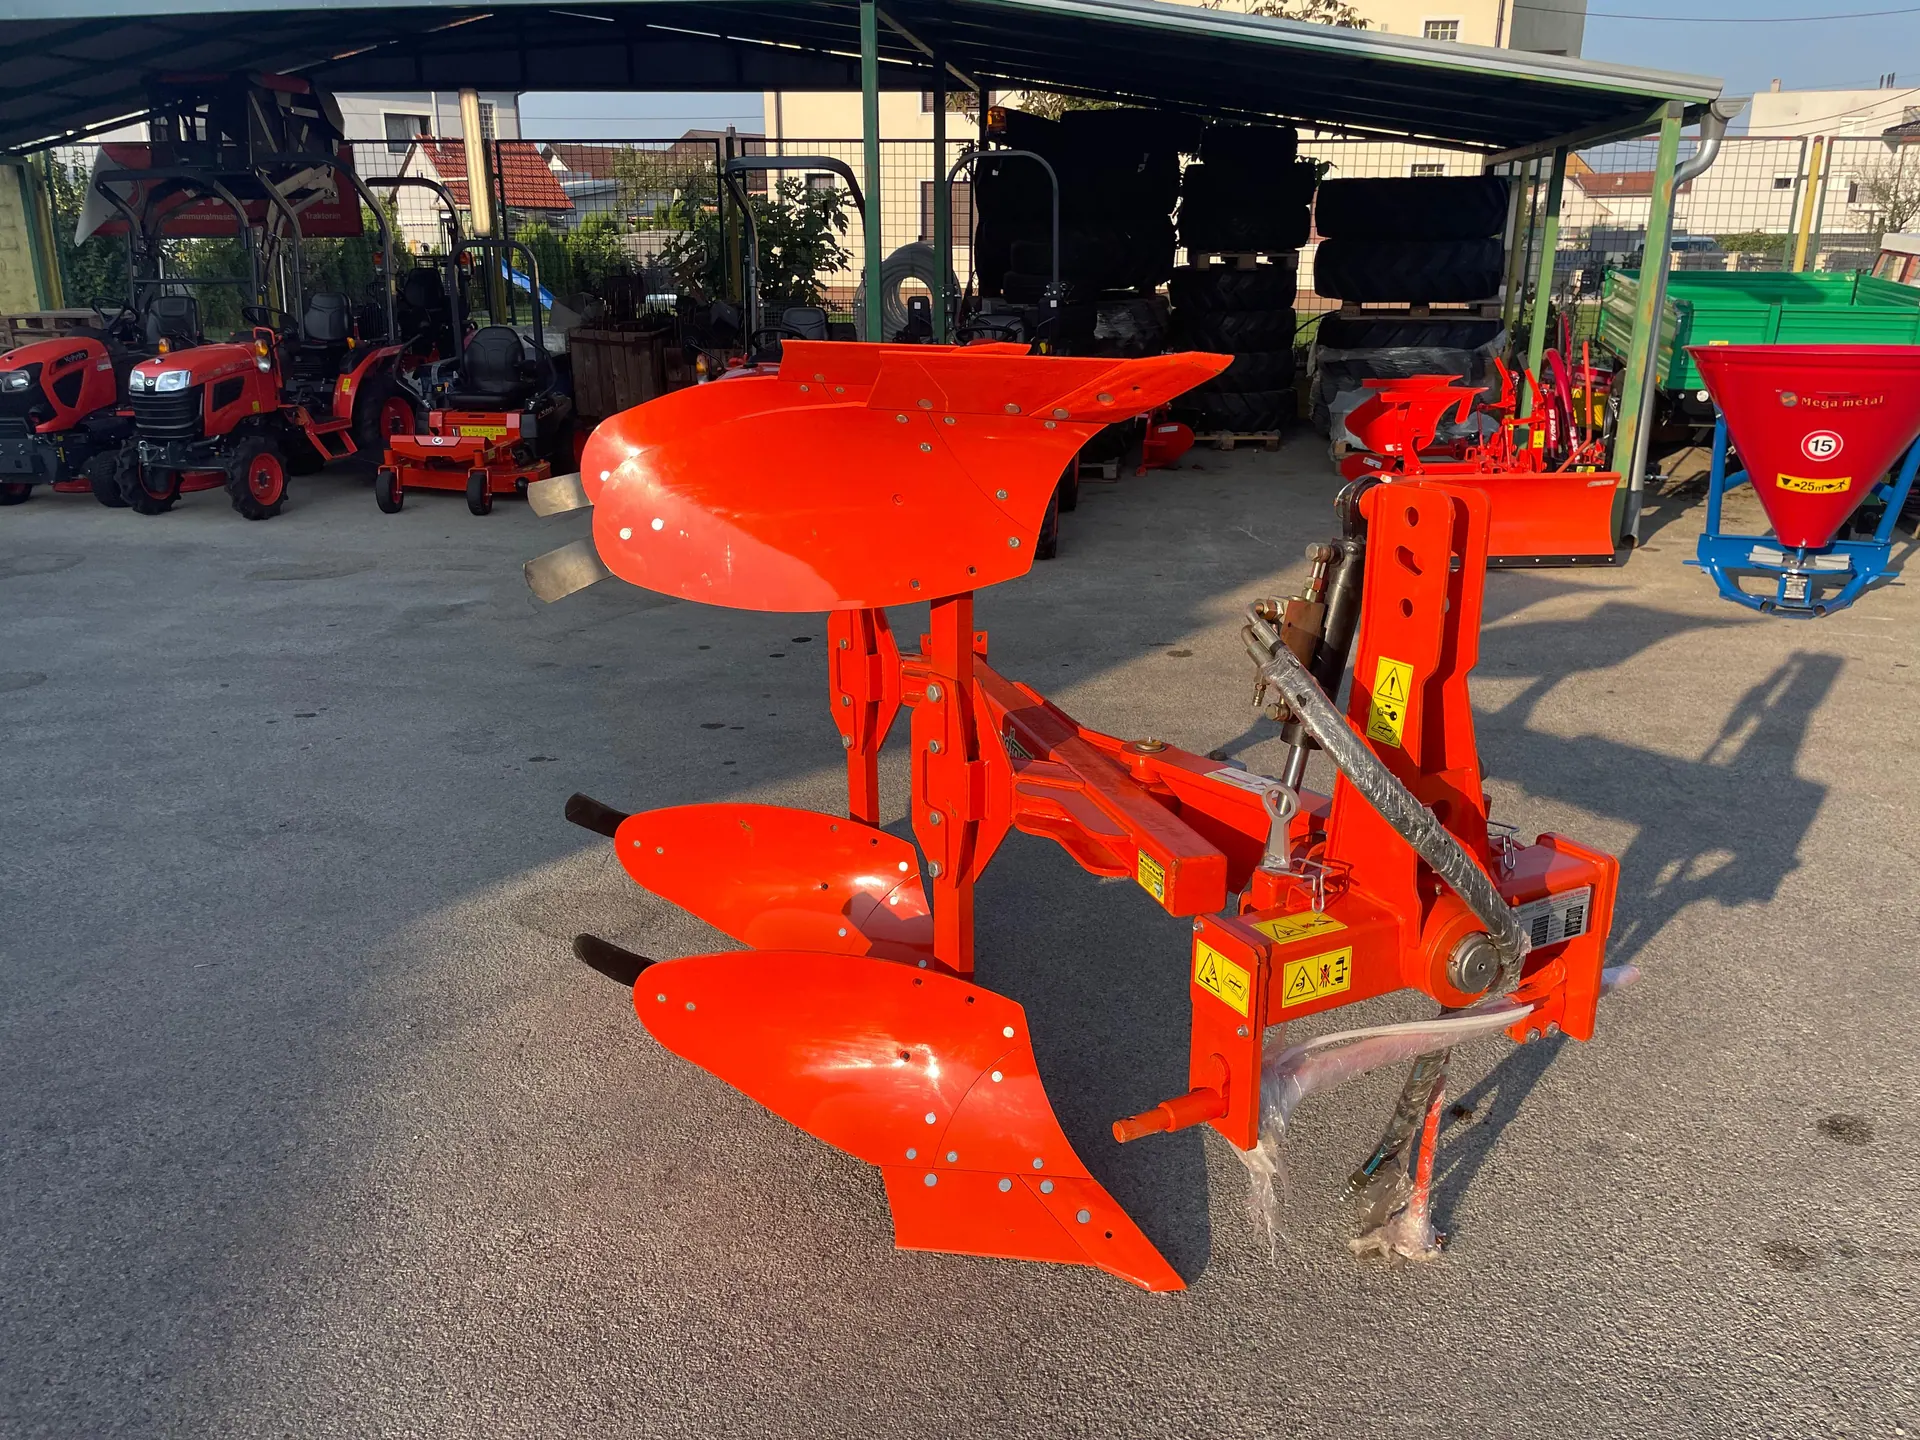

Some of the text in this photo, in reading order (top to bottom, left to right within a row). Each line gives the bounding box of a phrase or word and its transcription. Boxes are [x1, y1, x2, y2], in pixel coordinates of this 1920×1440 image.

[1801, 395, 1884, 409] Mega metal
[1811, 439, 1833, 453] 15
